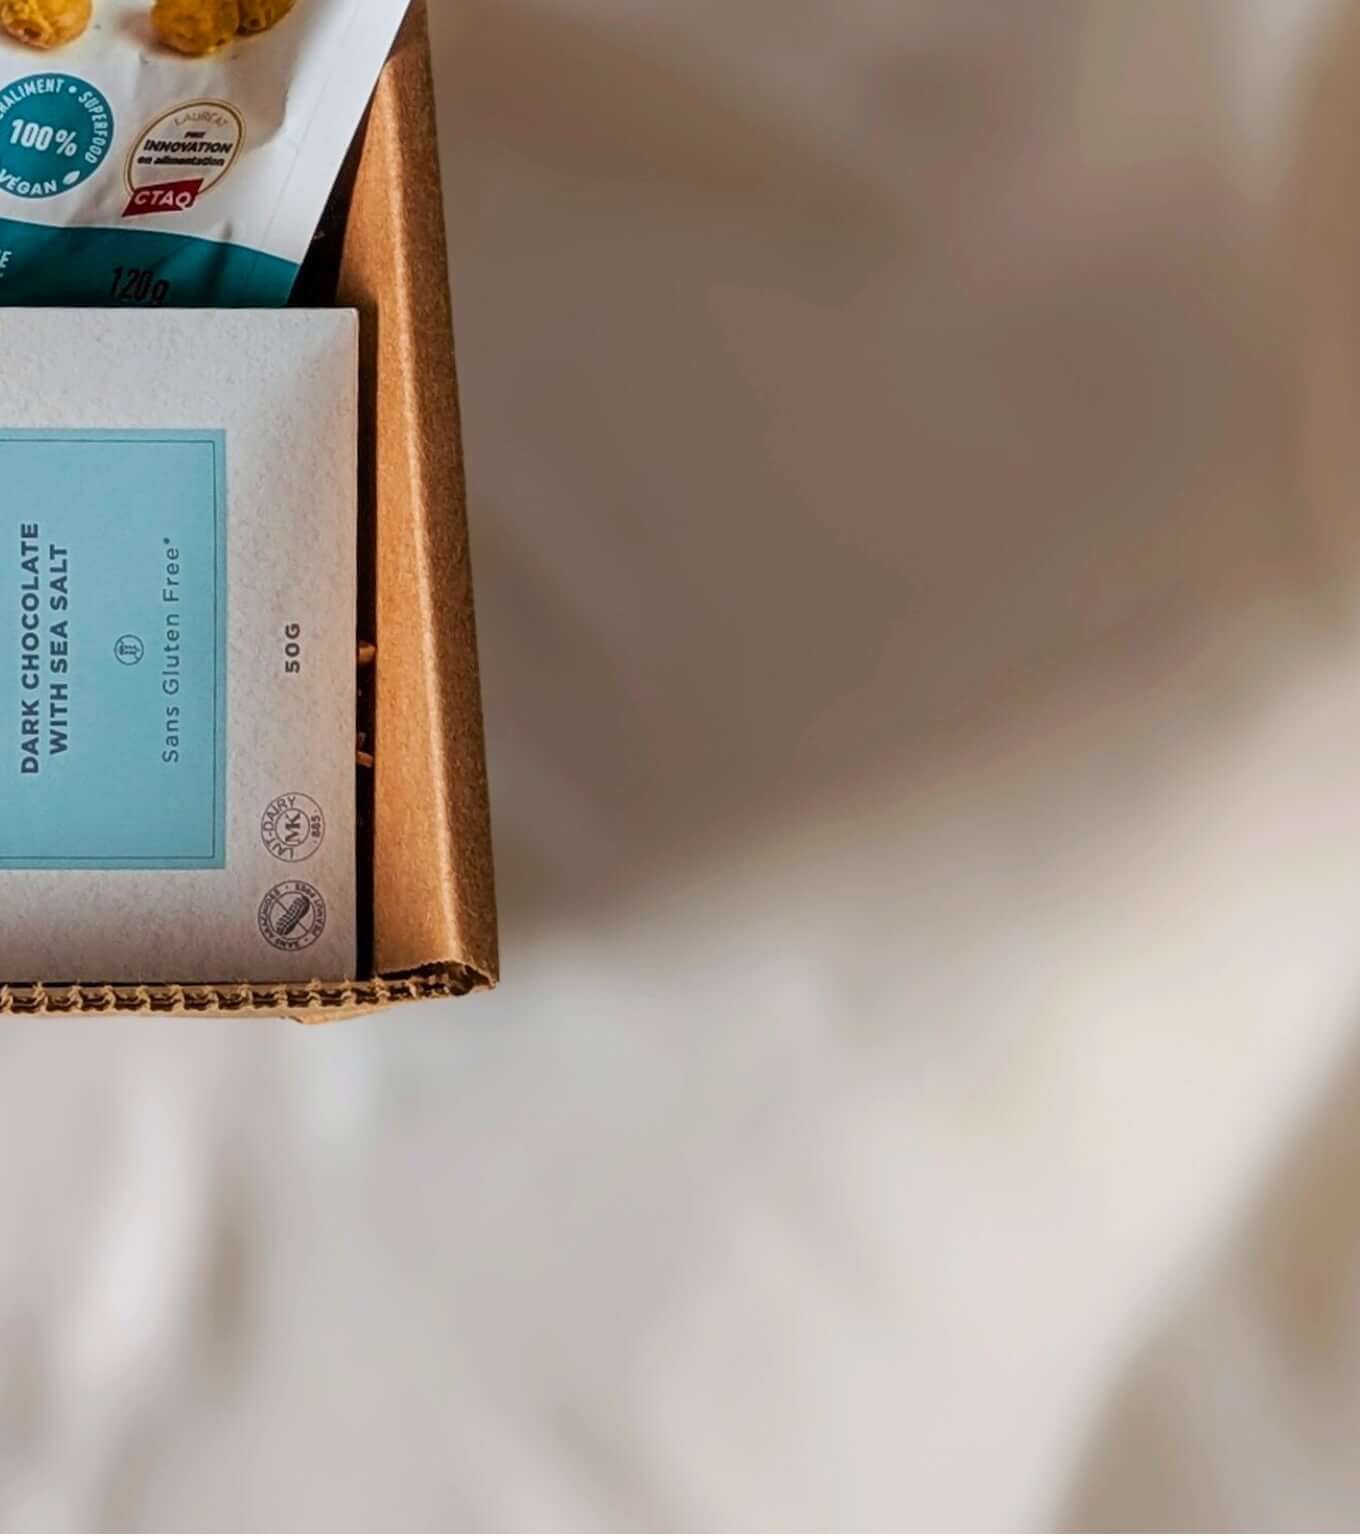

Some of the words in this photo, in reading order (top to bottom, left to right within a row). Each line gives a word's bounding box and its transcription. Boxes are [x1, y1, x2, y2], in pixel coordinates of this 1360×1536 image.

[9, 118, 78, 157] 100%
[78, 91, 109, 164] SUPERFOOD
[143, 139, 233, 153] INNOVATION
[134, 189, 192, 208] CTAQ
[20, 523, 40, 690] CHOCOLATE
[49, 544, 68, 611] SALT
[49, 620, 68, 674] SEA
[161, 613, 180, 695] Gluten
[285, 623, 301, 674] 50G
[20, 698, 40, 774] DARK
[49, 682, 68, 755] WITH
[162, 706, 179, 763] Sans
